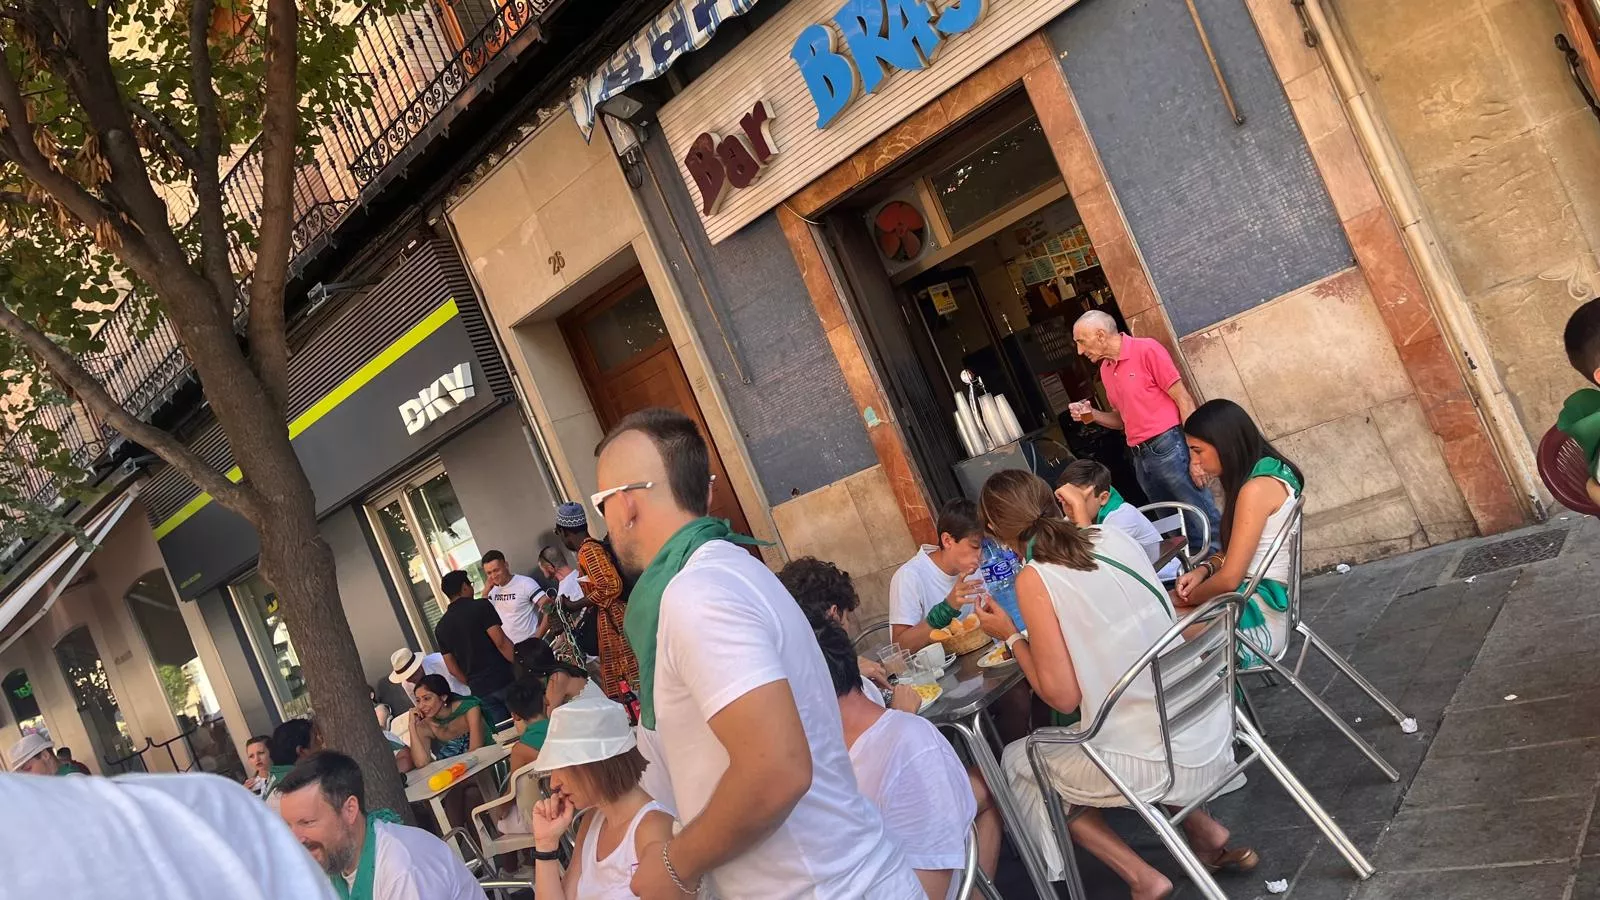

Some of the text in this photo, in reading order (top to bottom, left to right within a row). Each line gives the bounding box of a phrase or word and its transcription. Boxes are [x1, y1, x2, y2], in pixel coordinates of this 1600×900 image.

[684, 101, 774, 216] Bar
[548, 251, 566, 275] 26
[398, 362, 475, 436] DKV
